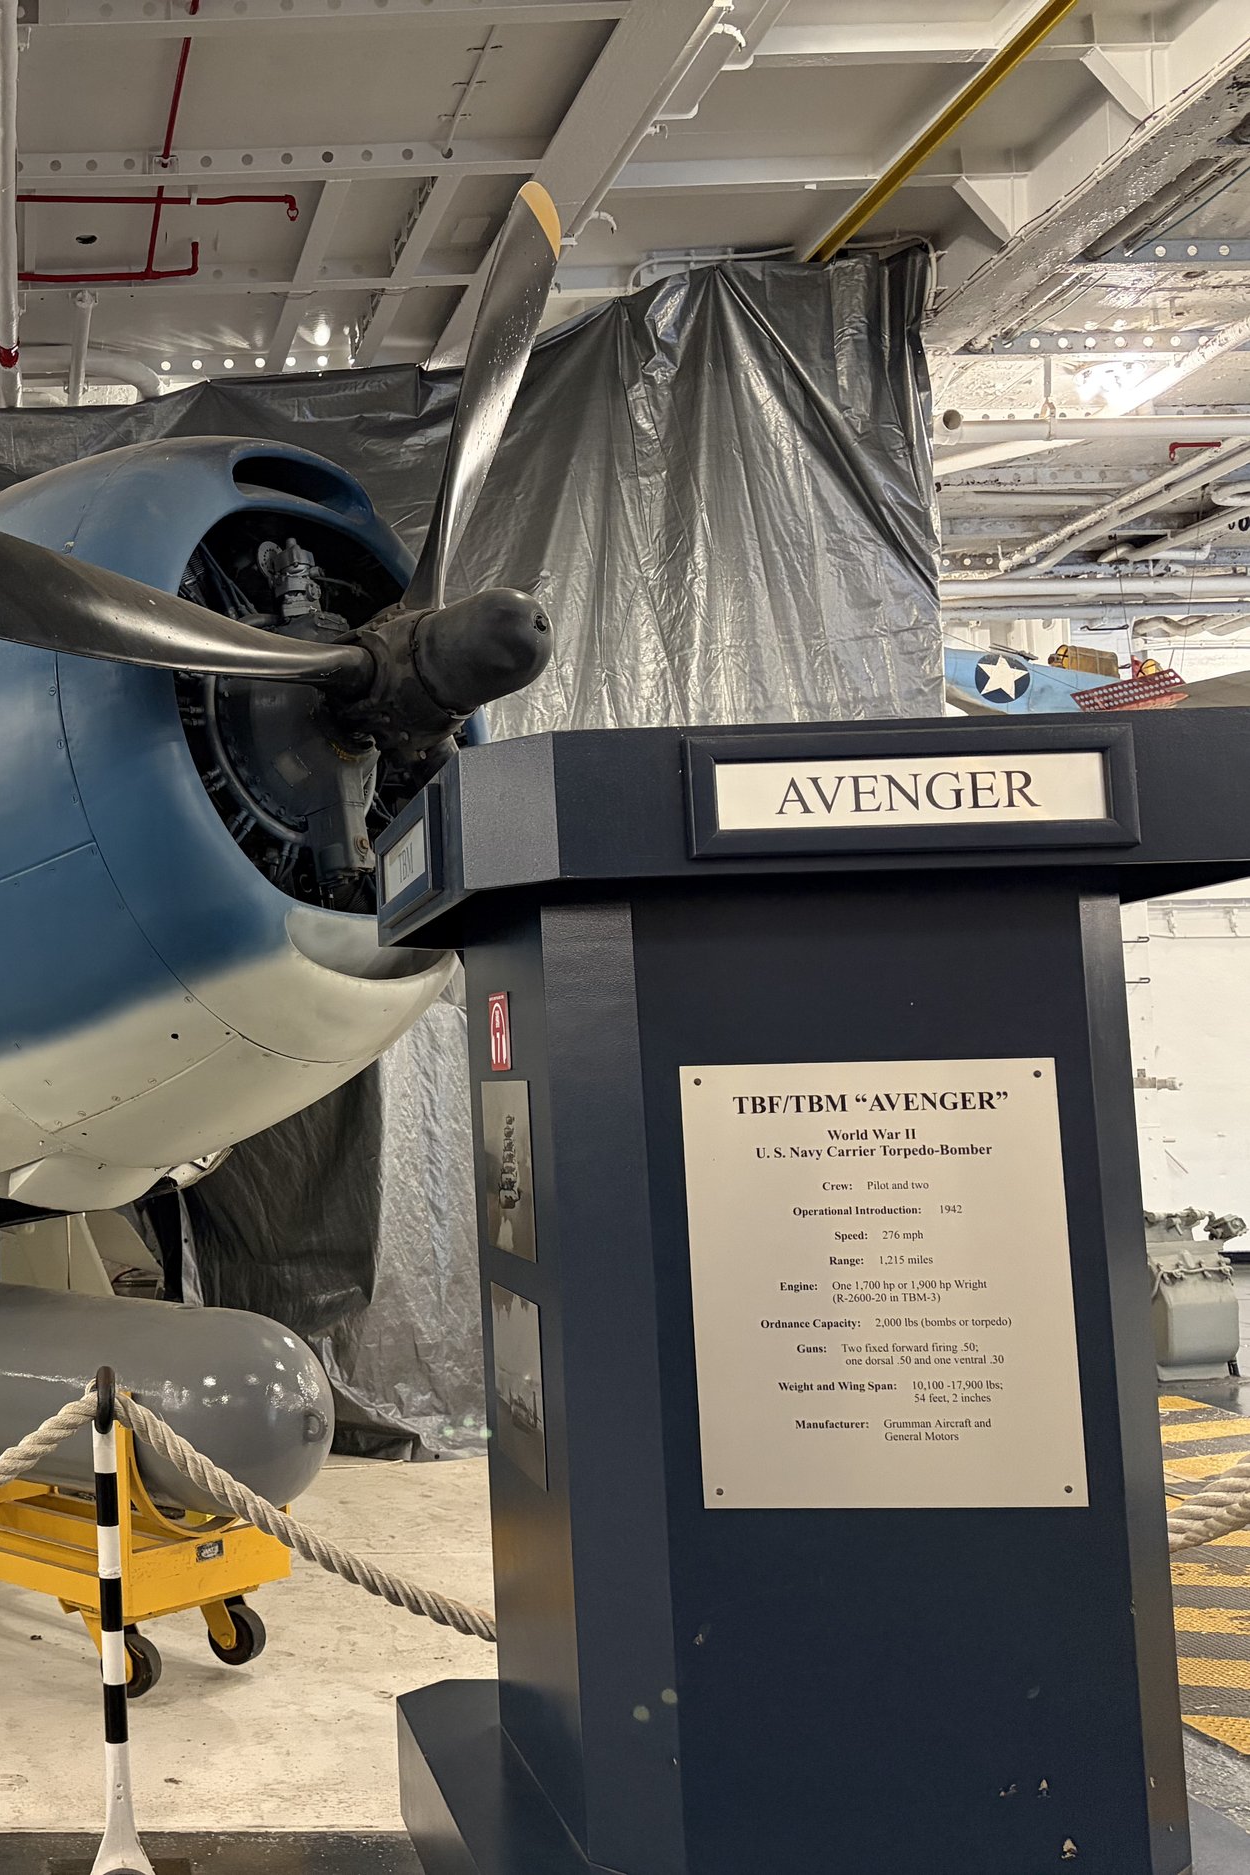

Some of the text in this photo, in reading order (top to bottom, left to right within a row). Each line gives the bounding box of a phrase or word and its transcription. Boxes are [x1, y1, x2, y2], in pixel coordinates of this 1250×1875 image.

[775, 770, 1041, 815] AVENGER
[398, 842, 414, 883] TBM
[733, 1091, 1008, 1114] TBF/TBM “AVENGER”
[827, 1129, 916, 1140] World War II
[756, 1144, 992, 1160] U. S. Navy Carrier Torpedo-Bomber
[822, 1182, 852, 1191] Crew:
[867, 1181, 889, 1190] Pilot
[892, 1181, 908, 1189] and
[793, 1205, 962, 1218] Operational Introduction: 1942
[835, 1230, 923, 1242] Speed: 276 mph
[830, 1255, 933, 1267] Range: 1,215 miles
[780, 1282, 817, 1293] Engine:
[832, 1282, 851, 1290] One
[856, 1281, 880, 1290] 1,700
[883, 1281, 895, 1291] hp
[912, 1280, 936, 1290] 1,900
[938, 1280, 951, 1291] hp
[954, 1280, 987, 1291] Wright
[833, 1293, 940, 1304] (R-2600-20 in TBM-3)
[761, 1320, 810, 1328] Ordnance
[813, 1319, 860, 1330] Capacity:
[876, 1318, 901, 1328] 2,000
[905, 1318, 918, 1326] lbs
[921, 1317, 956, 1328] (bombs
[972, 1317, 1011, 1328] torpedo)
[797, 1343, 978, 1354] Guns: Two fixed forward firing .50;
[865, 1356, 893, 1365] dorsal
[897, 1356, 911, 1364] .50
[915, 1355, 931, 1364] and
[954, 1355, 986, 1364] ventral
[990, 1355, 1004, 1364] .30
[778, 1380, 1003, 1393] Weight and Wing Span: 10,100 -17,900 lbs;
[915, 1393, 991, 1403] 54 feet, 2 inches
[796, 1418, 991, 1429] Manufacturer: Grumman Aircraft and
[885, 1432, 959, 1441] General Motors
